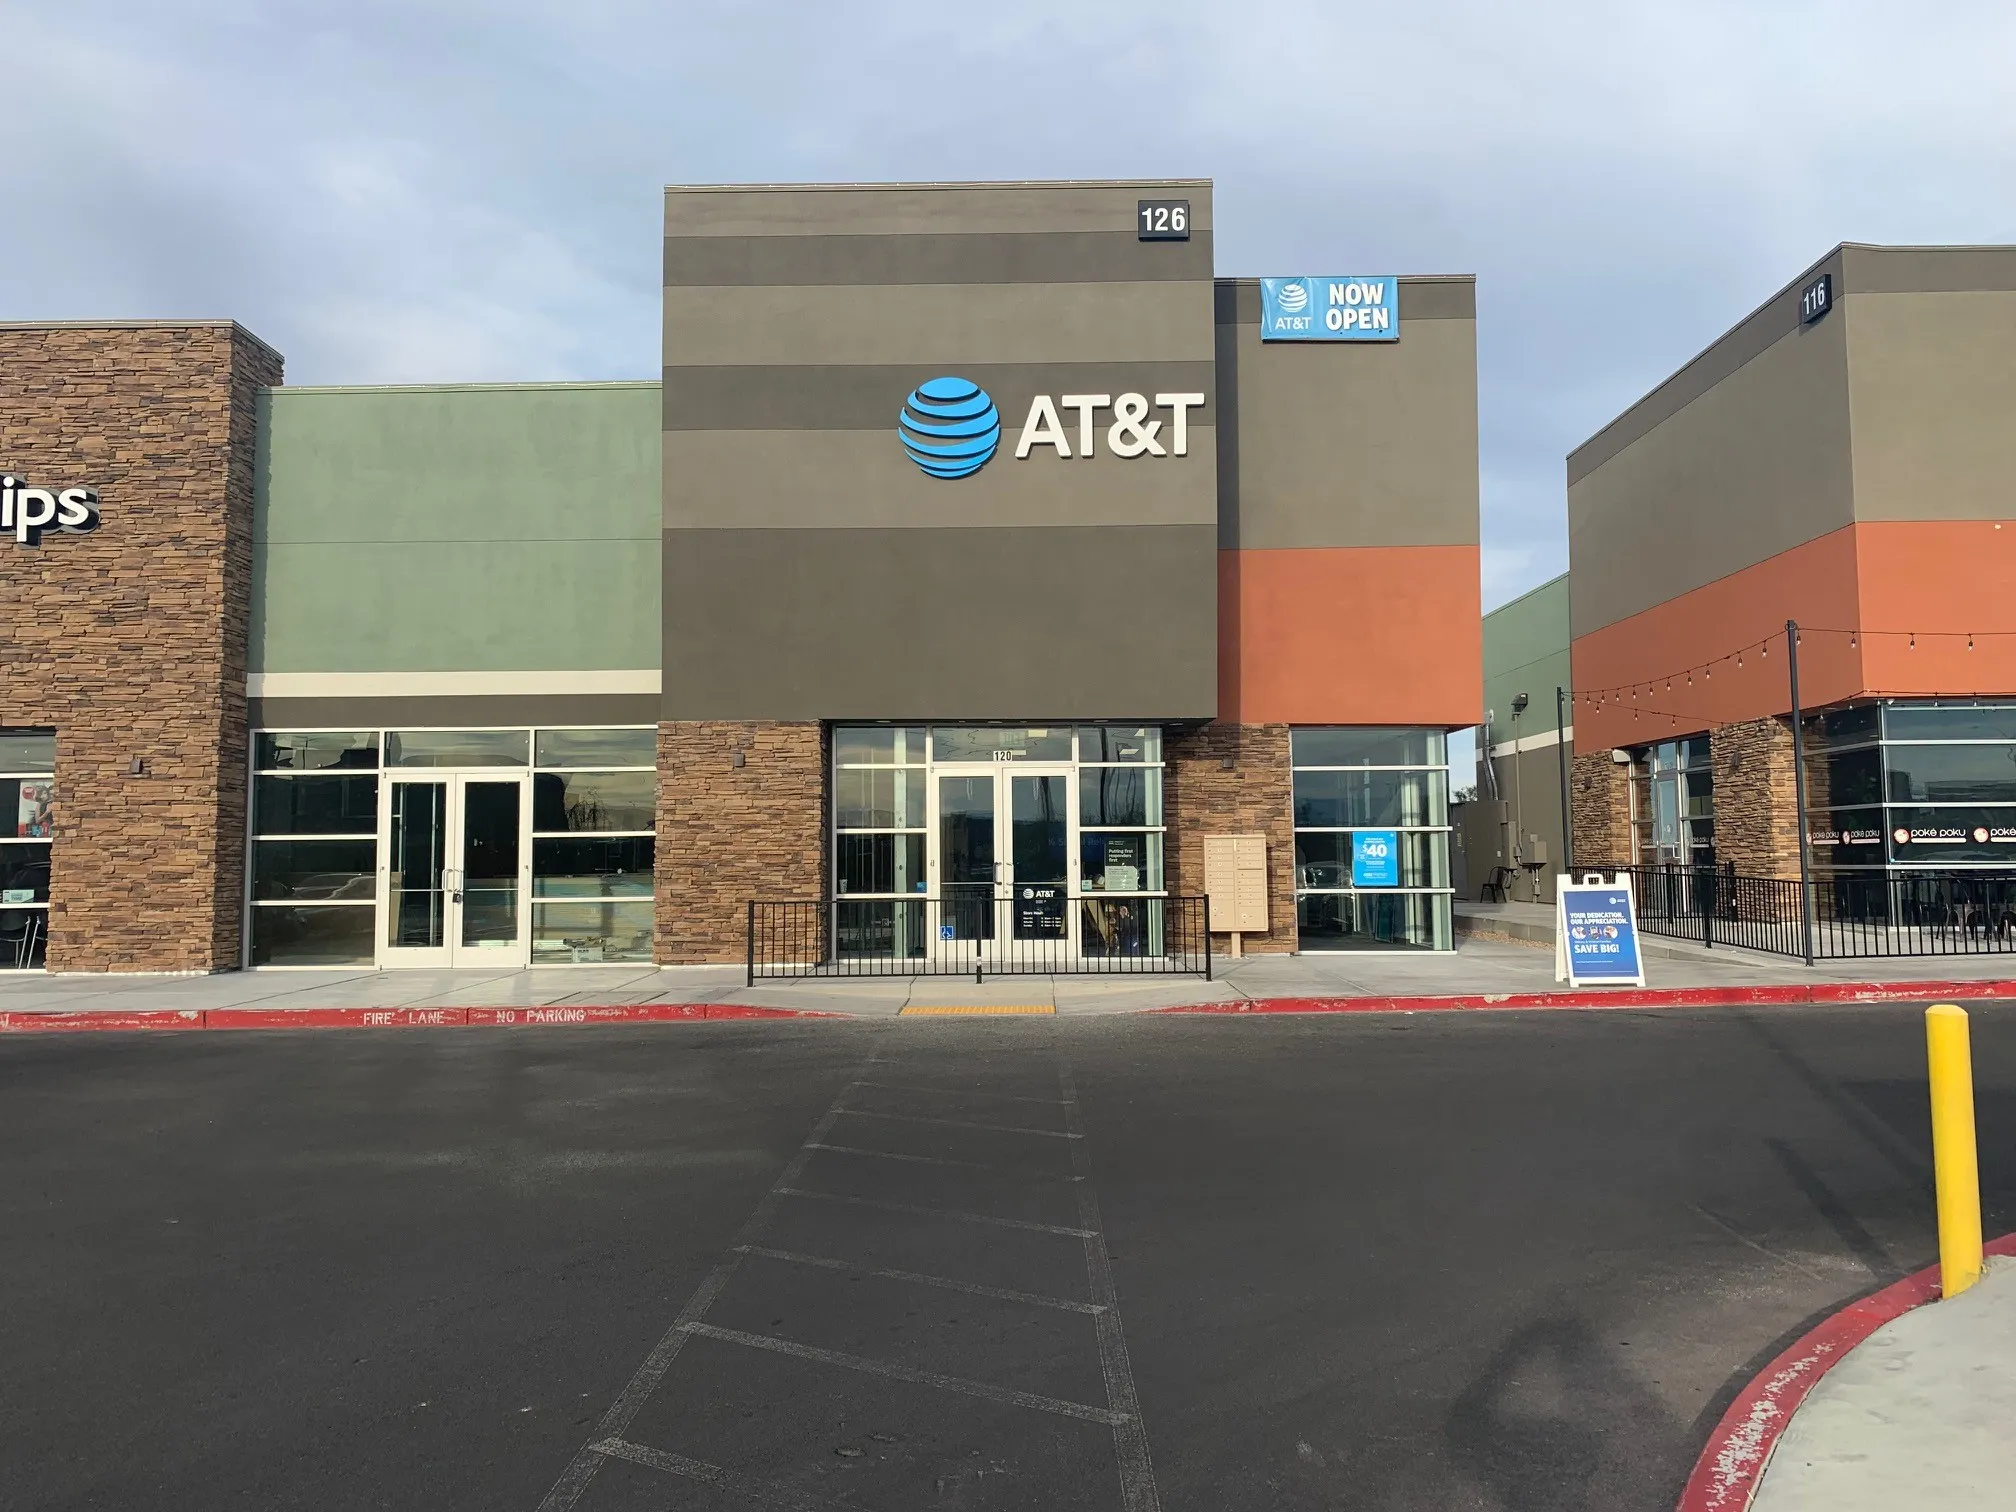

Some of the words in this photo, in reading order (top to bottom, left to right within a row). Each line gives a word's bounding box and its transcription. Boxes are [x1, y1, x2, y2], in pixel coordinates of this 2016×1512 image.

[1141, 207, 1186, 231] 126
[1329, 282, 1384, 306] NOW
[1803, 282, 1825, 315] 116
[1275, 316, 1311, 330] AT&T
[1325, 307, 1389, 331] OPEN
[1014, 392, 1205, 459] AT&T
[994, 751, 1012, 761] 120
[1939, 828, 1966, 837] poku
[1362, 843, 1388, 858] $40
[1035, 890, 1055, 898] AT&T
[1574, 944, 1598, 953] SAVE
[1600, 943, 1620, 953] BIG!
[363, 1012, 392, 1025] FIRE
[408, 1010, 445, 1025] LANE
[496, 1010, 515, 1023] NO
[526, 1008, 586, 1023] PARKING
